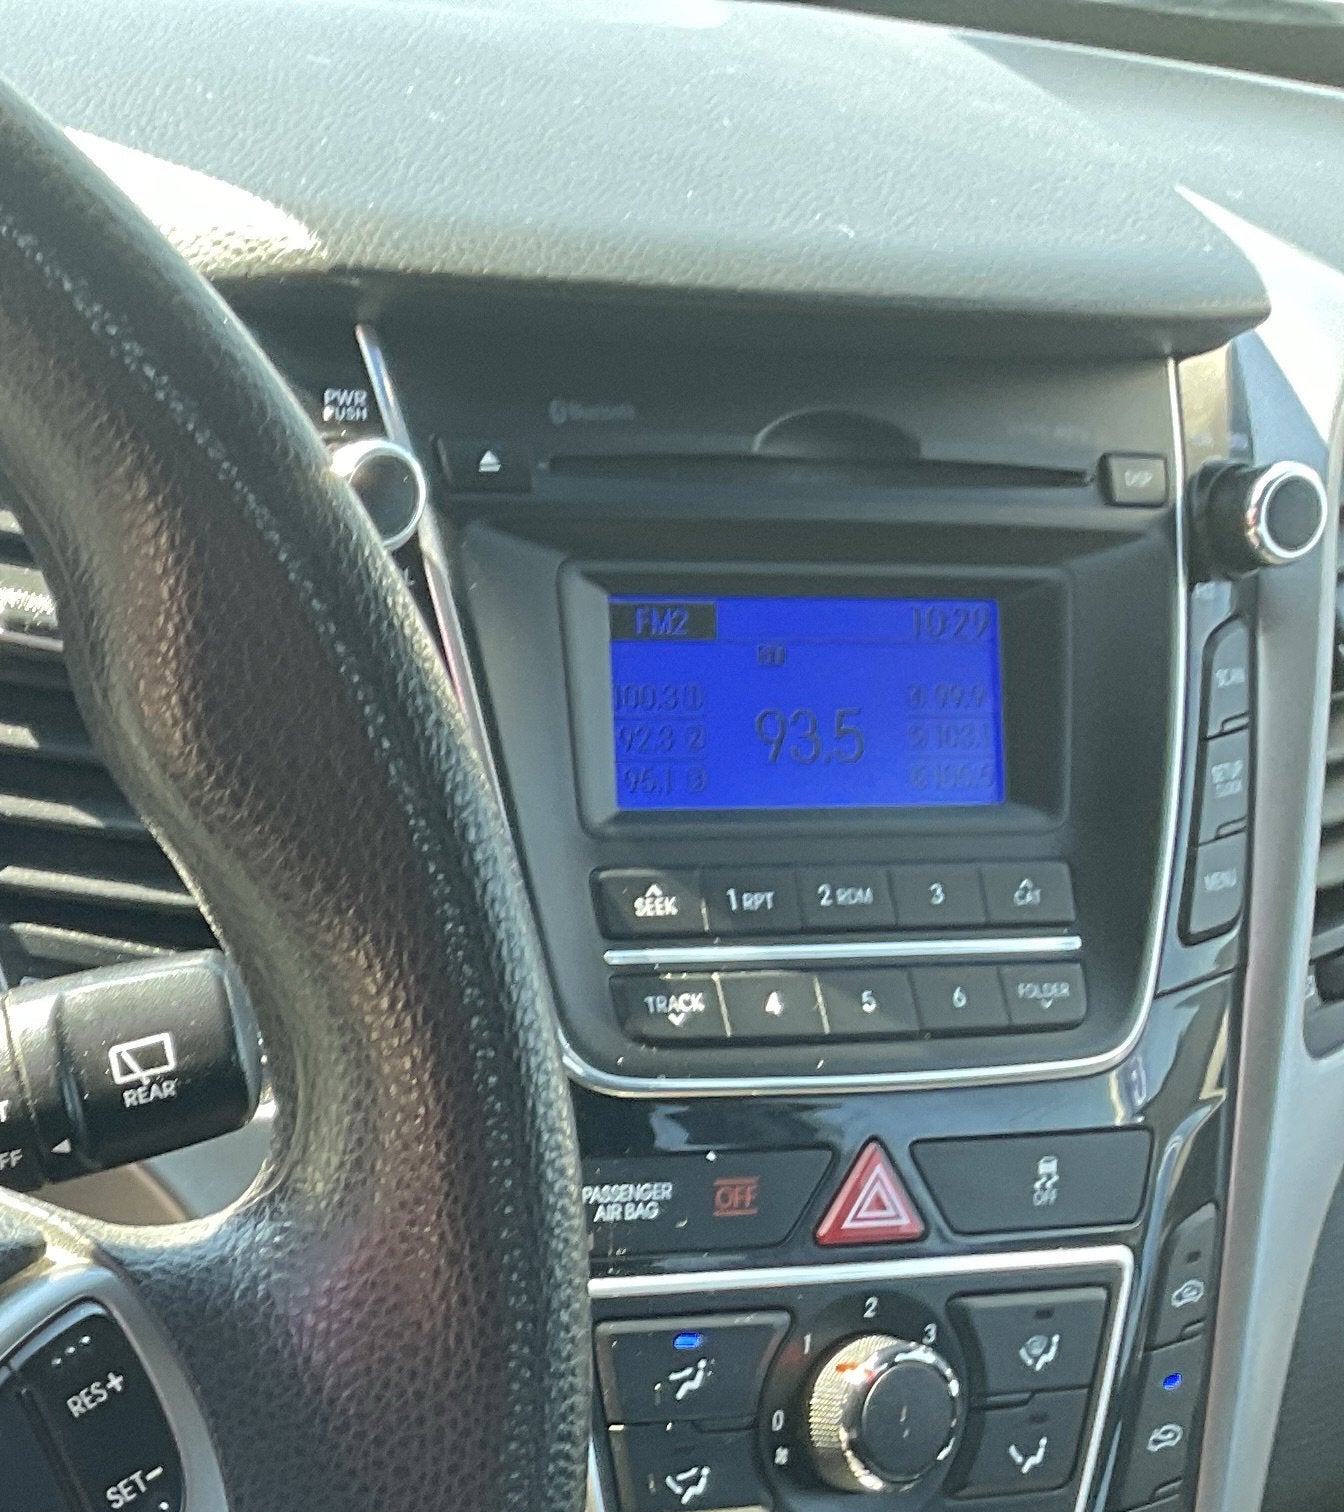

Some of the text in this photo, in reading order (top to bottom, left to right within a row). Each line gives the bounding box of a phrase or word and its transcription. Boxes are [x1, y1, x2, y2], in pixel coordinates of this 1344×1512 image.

[324, 387, 367, 407] PWR
[634, 607, 689, 636] FM2
[755, 708, 865, 764] 93.5
[726, 888, 739, 912] 1
[817, 883, 833, 907] 2
[928, 882, 946, 905] 3
[633, 897, 678, 917] SEEK
[644, 993, 706, 1015] TRACK
[765, 992, 783, 1016] 4
[863, 992, 877, 1013] 5
[953, 985, 967, 1009] 6
[122, 1078, 178, 1109] REAR
[581, 1181, 673, 1205] PASSENGER
[715, 1186, 756, 1210] OFF
[863, 1296, 879, 1318] 2
[803, 1333, 812, 1355] 1
[922, 1323, 937, 1344] 3
